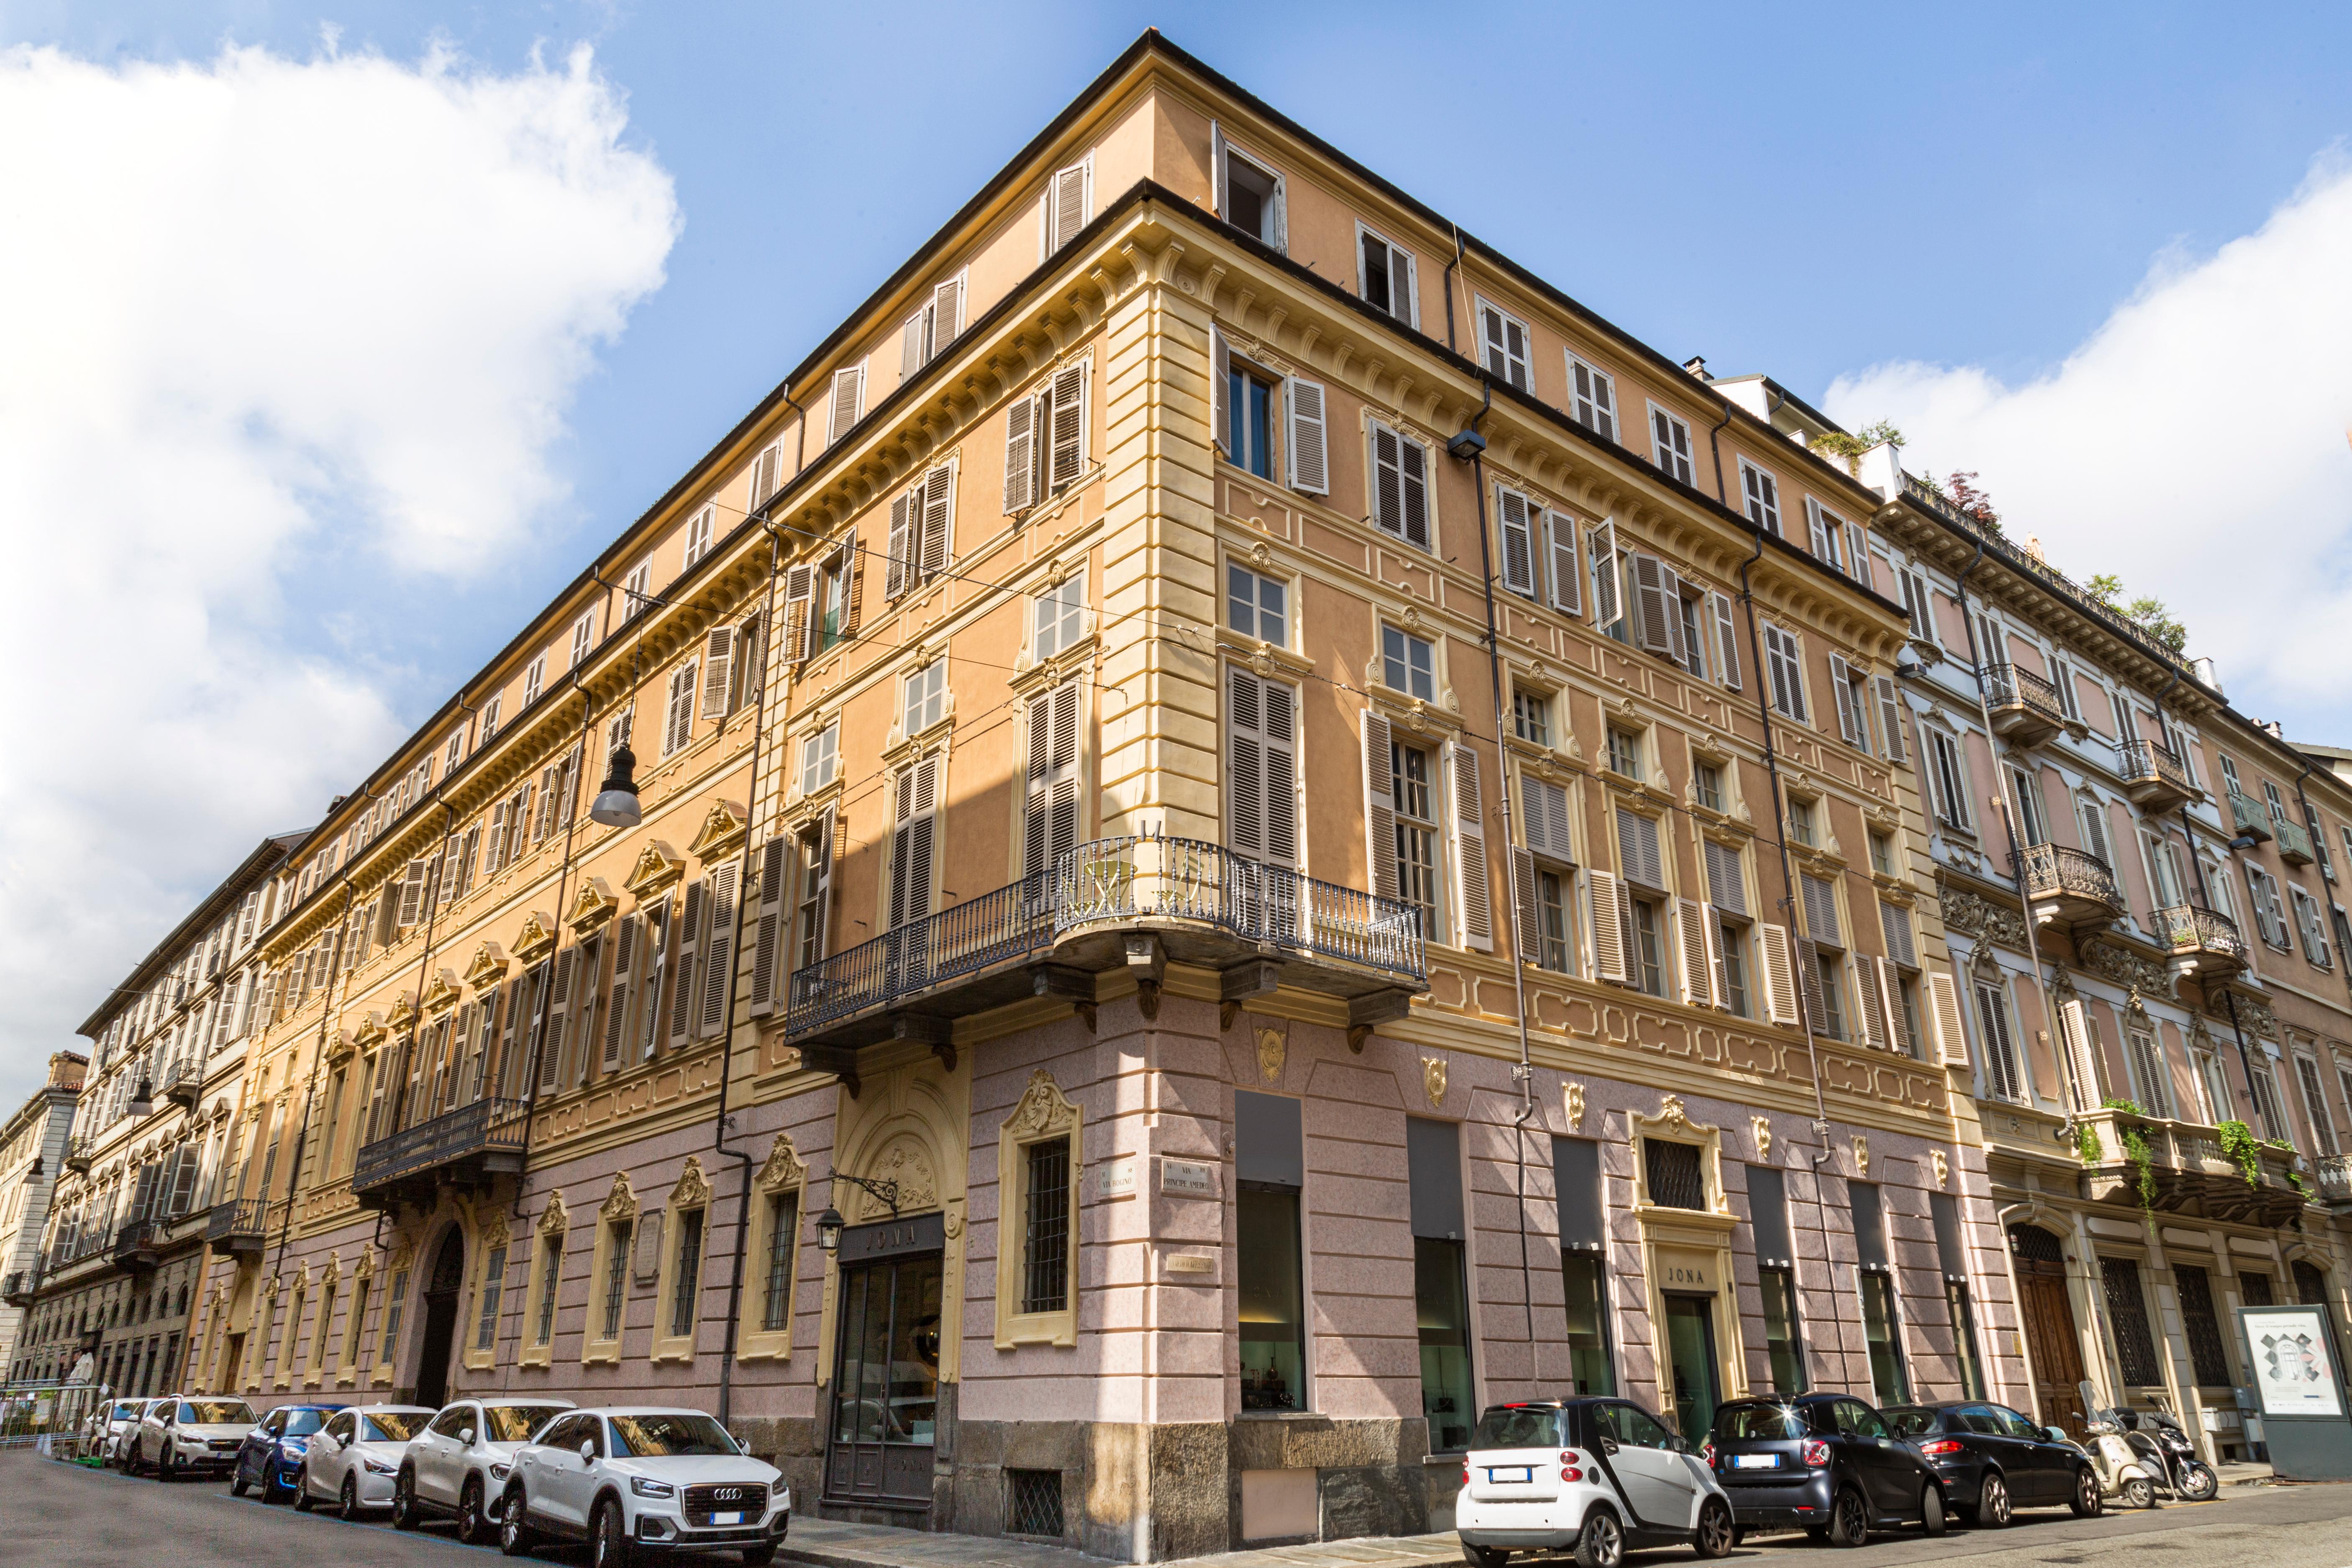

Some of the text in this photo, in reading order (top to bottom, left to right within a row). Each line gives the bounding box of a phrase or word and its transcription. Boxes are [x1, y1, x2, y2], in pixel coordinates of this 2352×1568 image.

[1113, 1177, 1132, 1187] BOGINO
[1163, 1178, 1209, 1189] PRINCIPE AMEDEO
[866, 1225, 915, 1250] JONA
[1669, 1268, 1704, 1284] JONA
